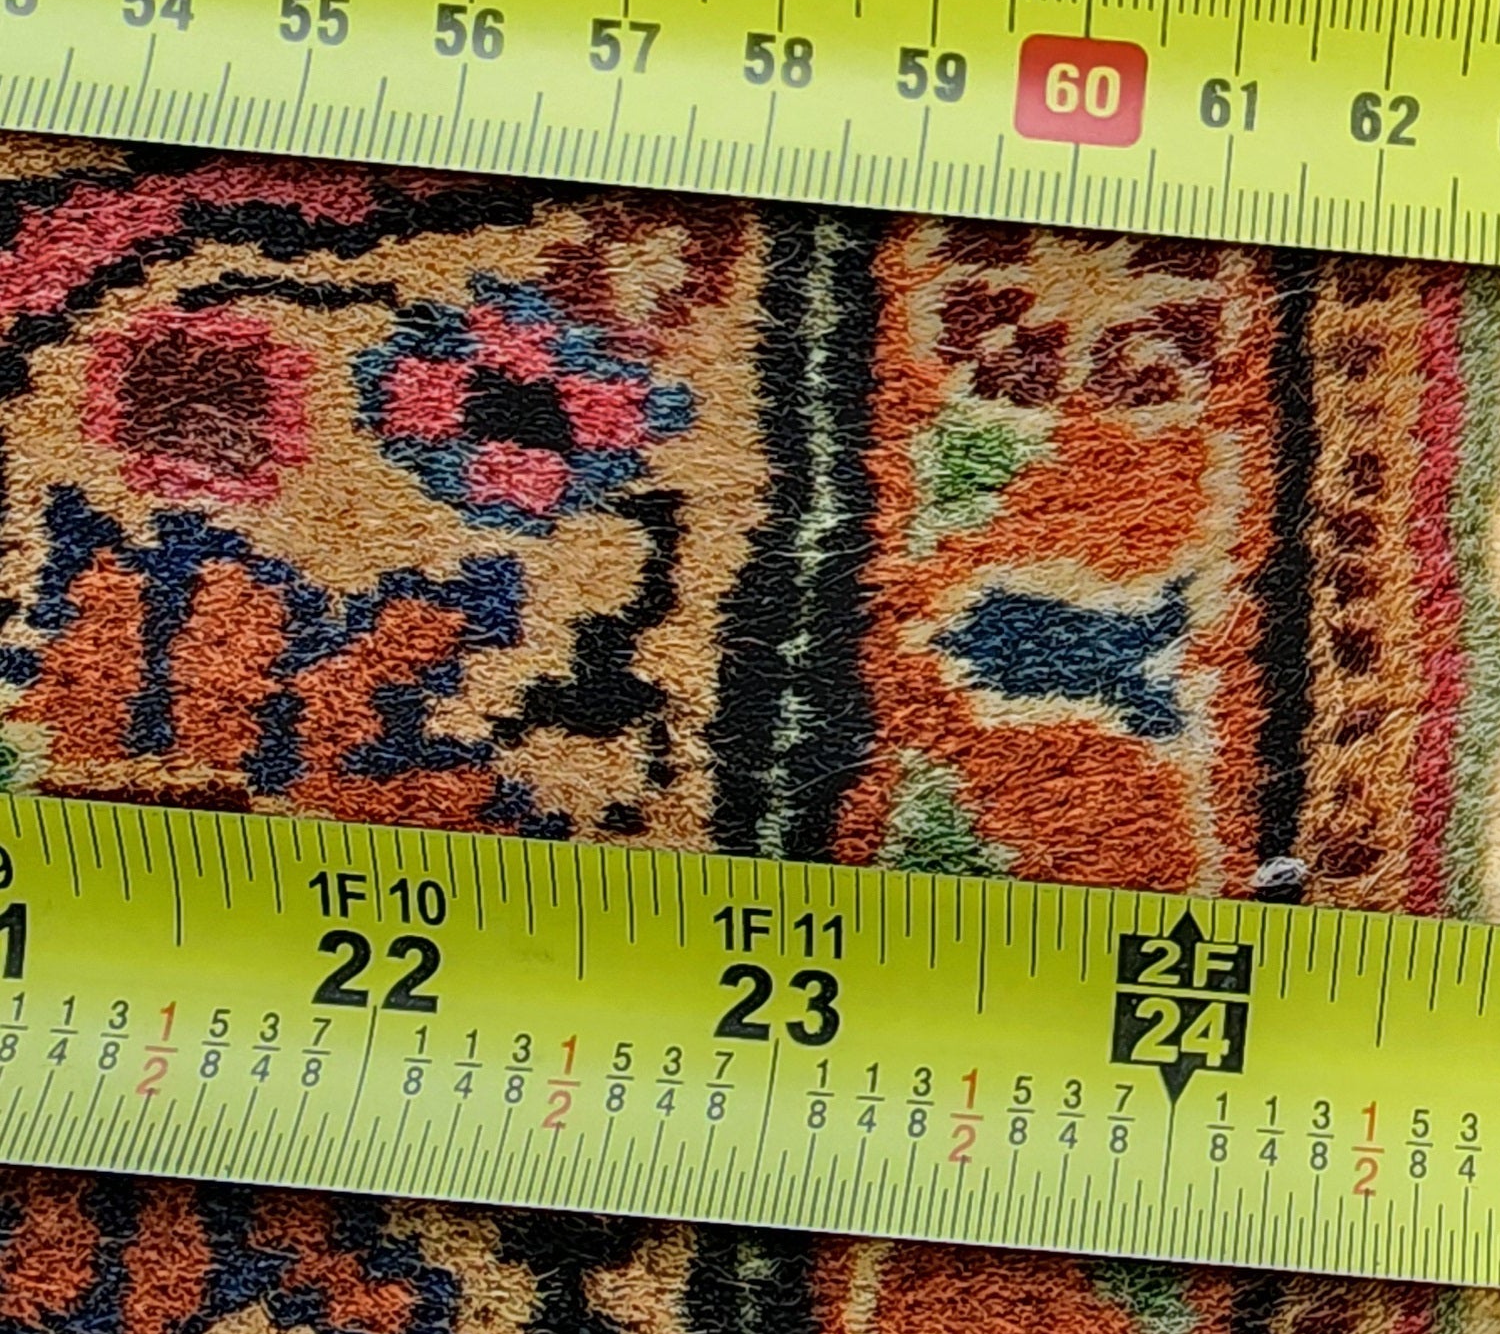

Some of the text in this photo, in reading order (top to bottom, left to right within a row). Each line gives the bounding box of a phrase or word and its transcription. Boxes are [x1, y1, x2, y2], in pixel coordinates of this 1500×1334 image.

[434, 3, 504, 60] 56
[589, 18, 660, 74] 57
[744, 33, 814, 88] 58
[897, 47, 967, 103] 59
[1045, 63, 1120, 118] 60
[1200, 78, 1257, 131] 61
[1350, 92, 1420, 146] 62
[309, 872, 446, 926] 1F 10
[714, 906, 842, 959] 1F 11
[0, 903, 26, 979] 1
[311, 929, 441, 1014] 22
[714, 963, 840, 1046] 23
[1131, 998, 1230, 1067] 24
[1138, 939, 1238, 987] 2F
